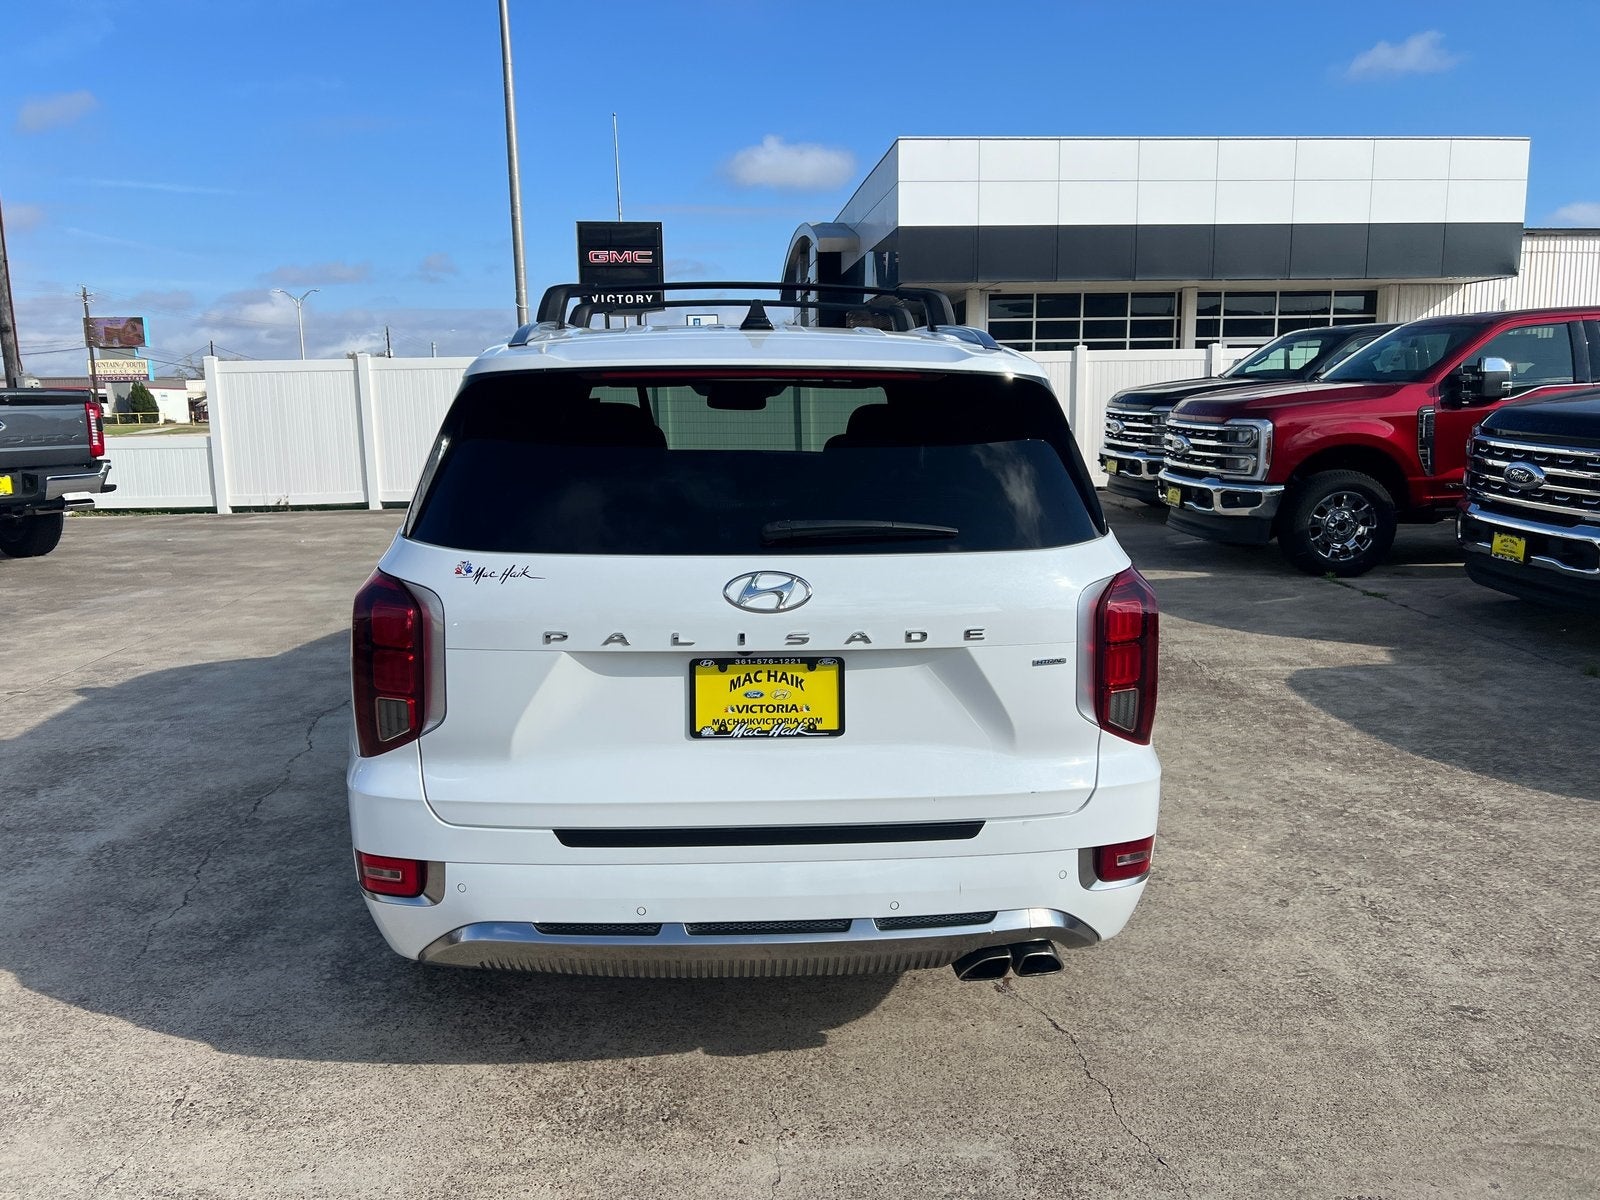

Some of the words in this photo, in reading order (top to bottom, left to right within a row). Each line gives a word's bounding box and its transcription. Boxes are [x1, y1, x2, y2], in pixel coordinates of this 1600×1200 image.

[588, 250, 653, 264] GMC
[591, 294, 653, 304] VICTORY
[1509, 468, 1529, 482] Ford
[472, 566, 497, 585] Mac
[499, 564, 538, 585] Haik
[542, 627, 987, 646] PALISADE
[729, 669, 763, 693] MAC
[766, 669, 806, 692] HAIK
[745, 690, 763, 698] Ford
[735, 703, 800, 714] VICTORIA
[729, 723, 764, 738] Mac
[767, 723, 812, 738] Haik
